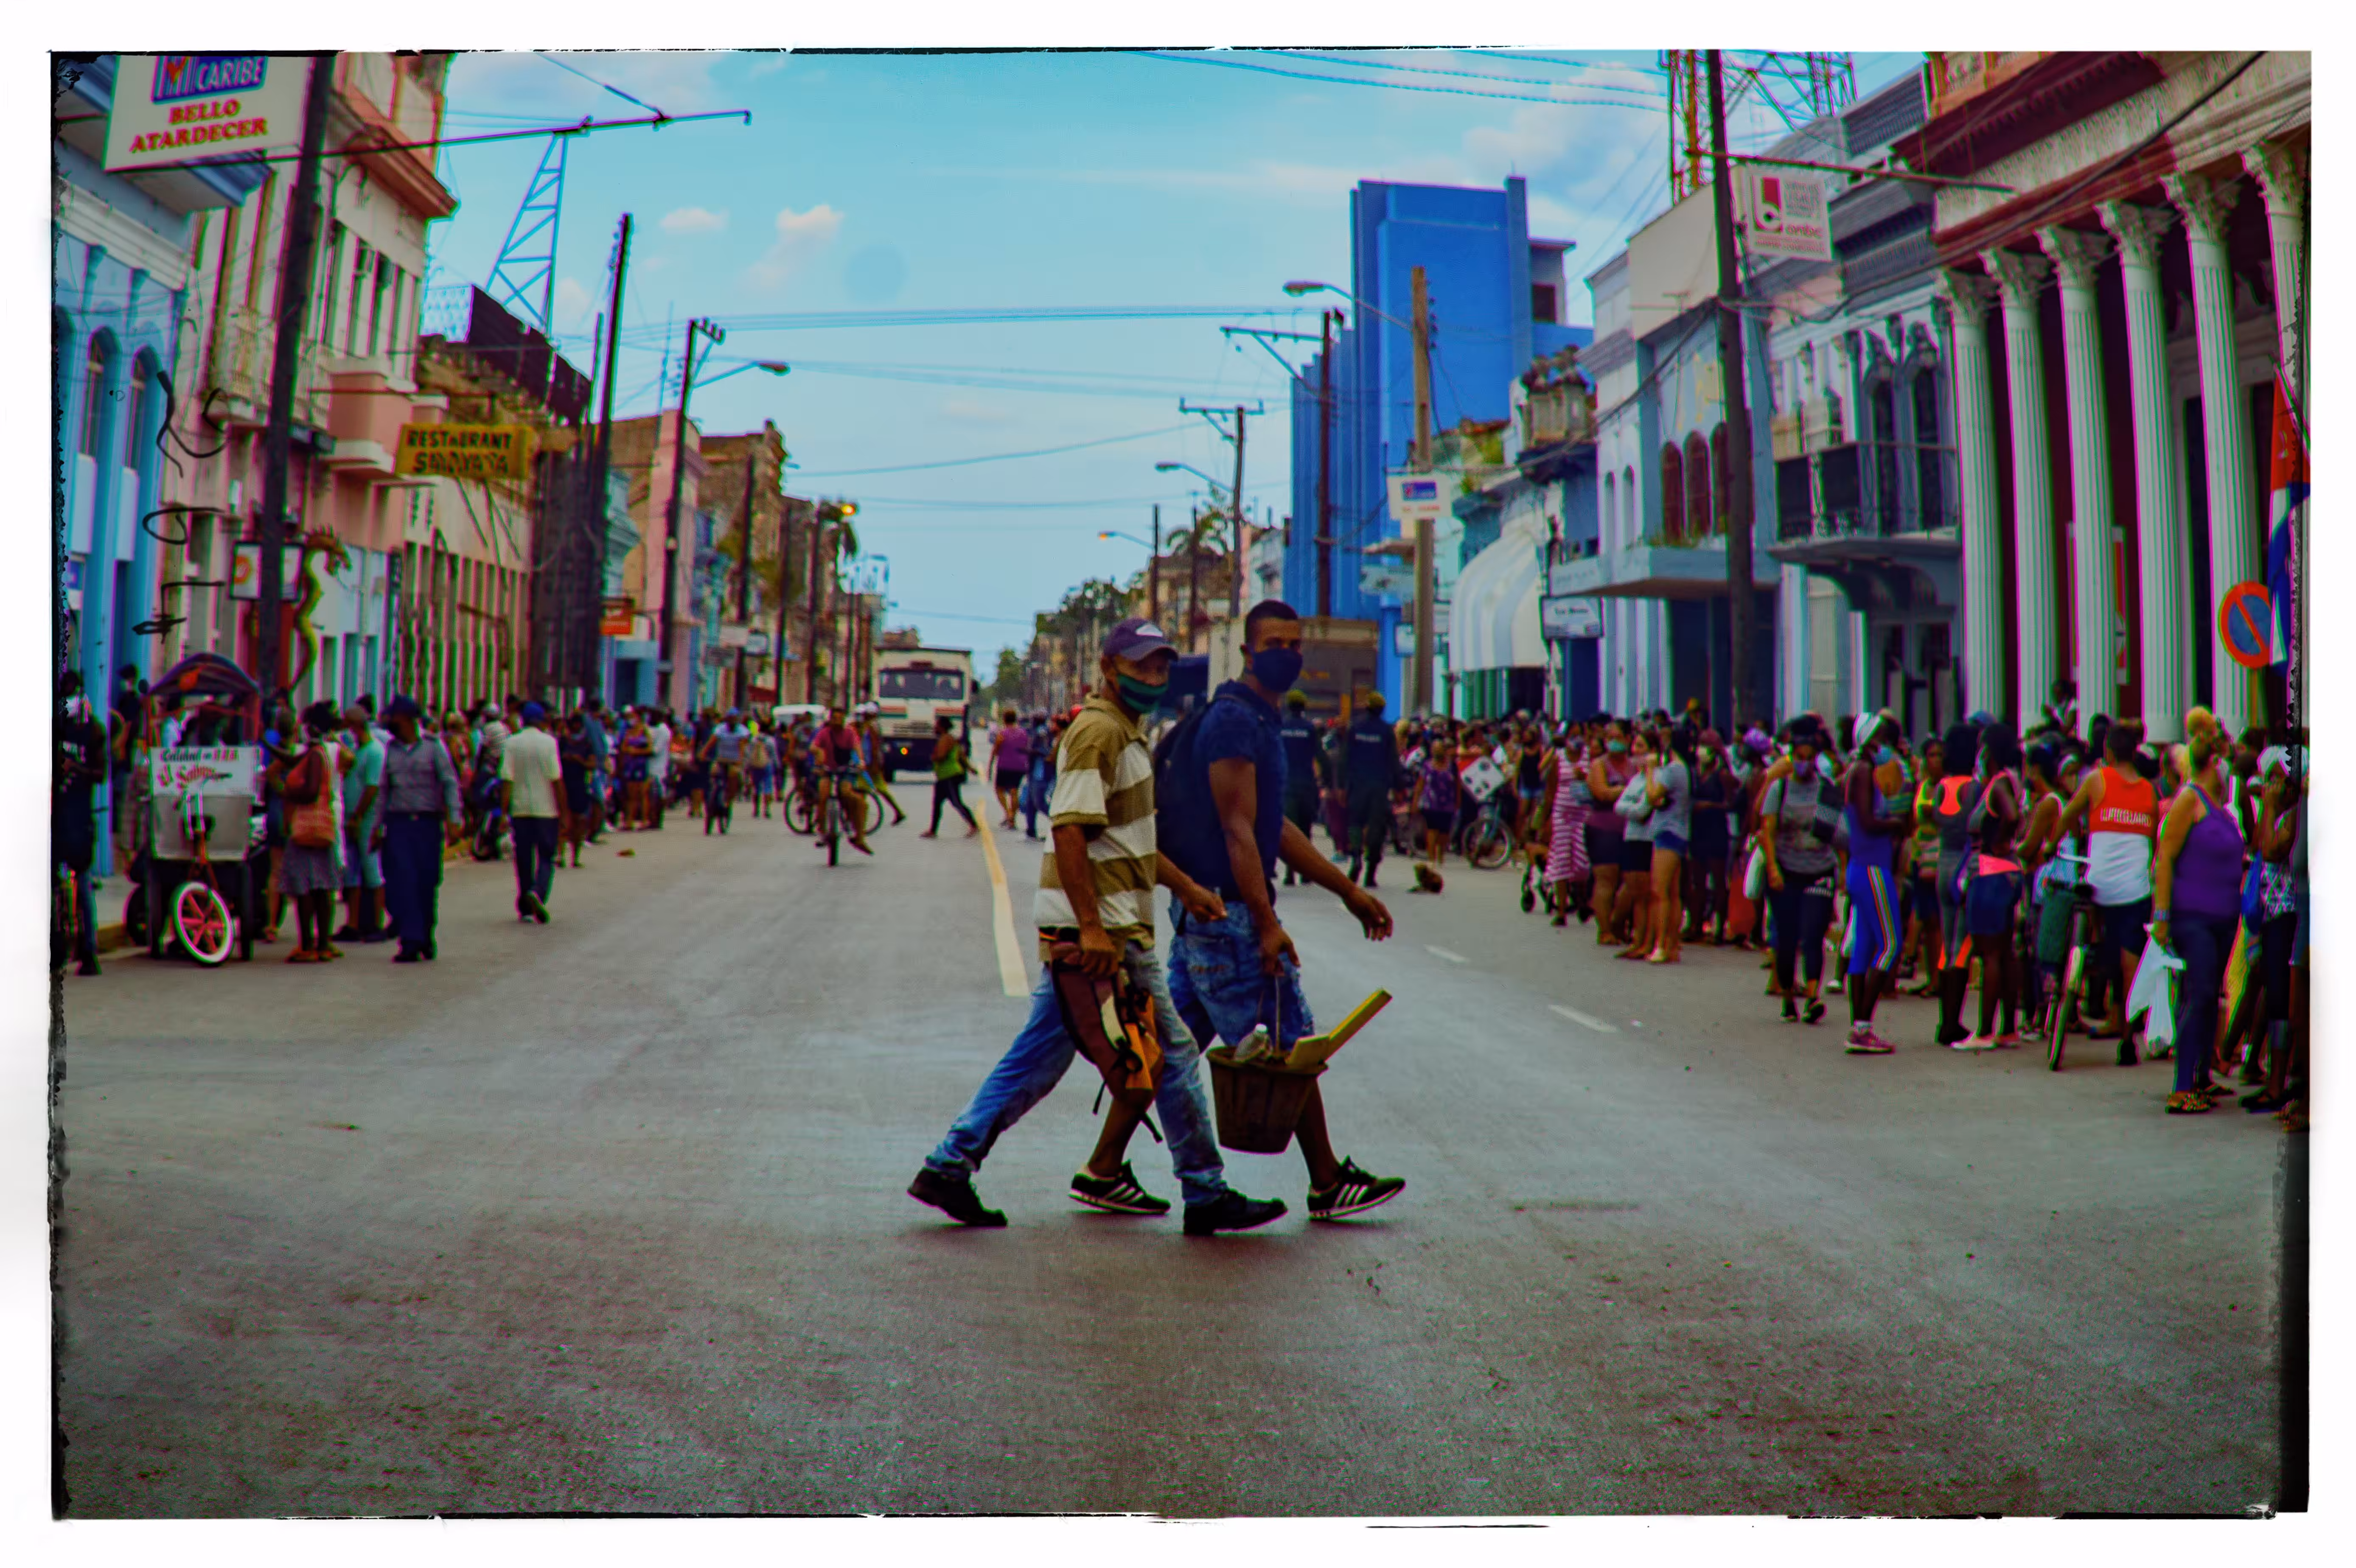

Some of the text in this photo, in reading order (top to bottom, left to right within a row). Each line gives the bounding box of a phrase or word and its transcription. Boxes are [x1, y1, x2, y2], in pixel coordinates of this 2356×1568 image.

[196, 58, 264, 91] CARIBE
[168, 98, 241, 125] BELLO
[129, 116, 268, 153] ATARDECER
[407, 429, 512, 448] RESTAURANT
[2100, 807, 2152, 828] LIFEGUARD
